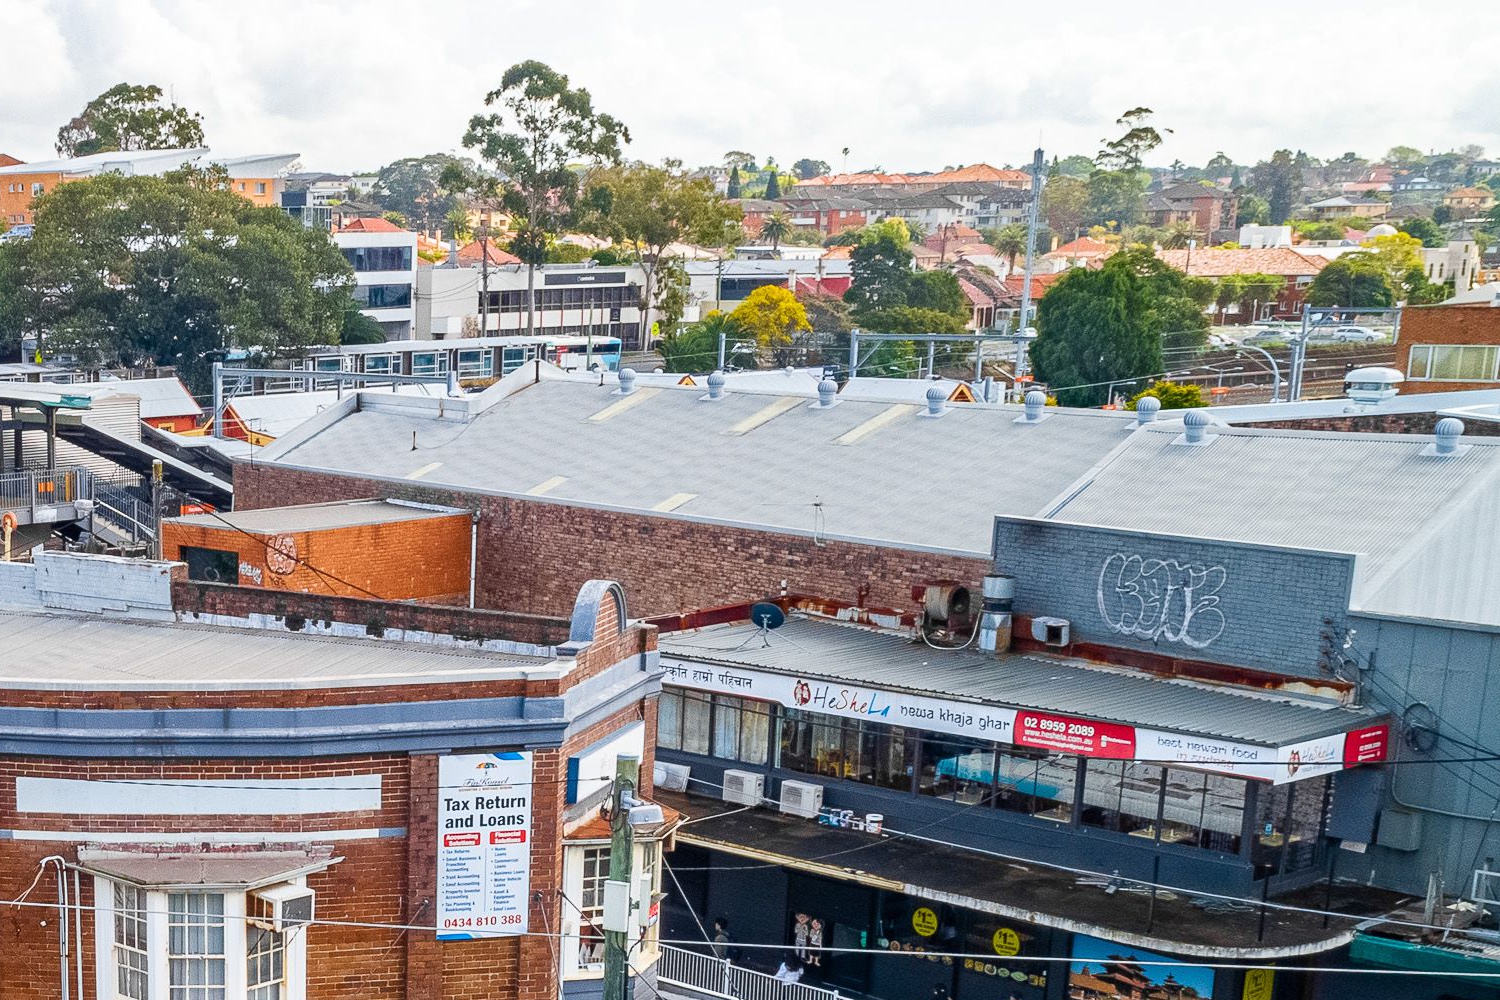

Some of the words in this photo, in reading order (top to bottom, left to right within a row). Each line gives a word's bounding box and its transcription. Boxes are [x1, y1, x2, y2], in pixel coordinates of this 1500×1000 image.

[814, 685, 890, 717] HeSheLa
[900, 704, 934, 720] newa
[939, 708, 973, 726] khaja
[979, 714, 1010, 731] ghar
[1024, 716, 1038, 728] 02
[1040, 719, 1066, 732] 8959
[1068, 723, 1095, 736] 2089
[1232, 744, 1258, 760] food
[444, 798, 470, 811] Tax
[475, 796, 526, 810] Return
[445, 814, 473, 828] and
[480, 814, 525, 827] Loans
[444, 918, 472, 928] 0434
[476, 916, 497, 926] 810
[501, 914, 522, 925] 388
